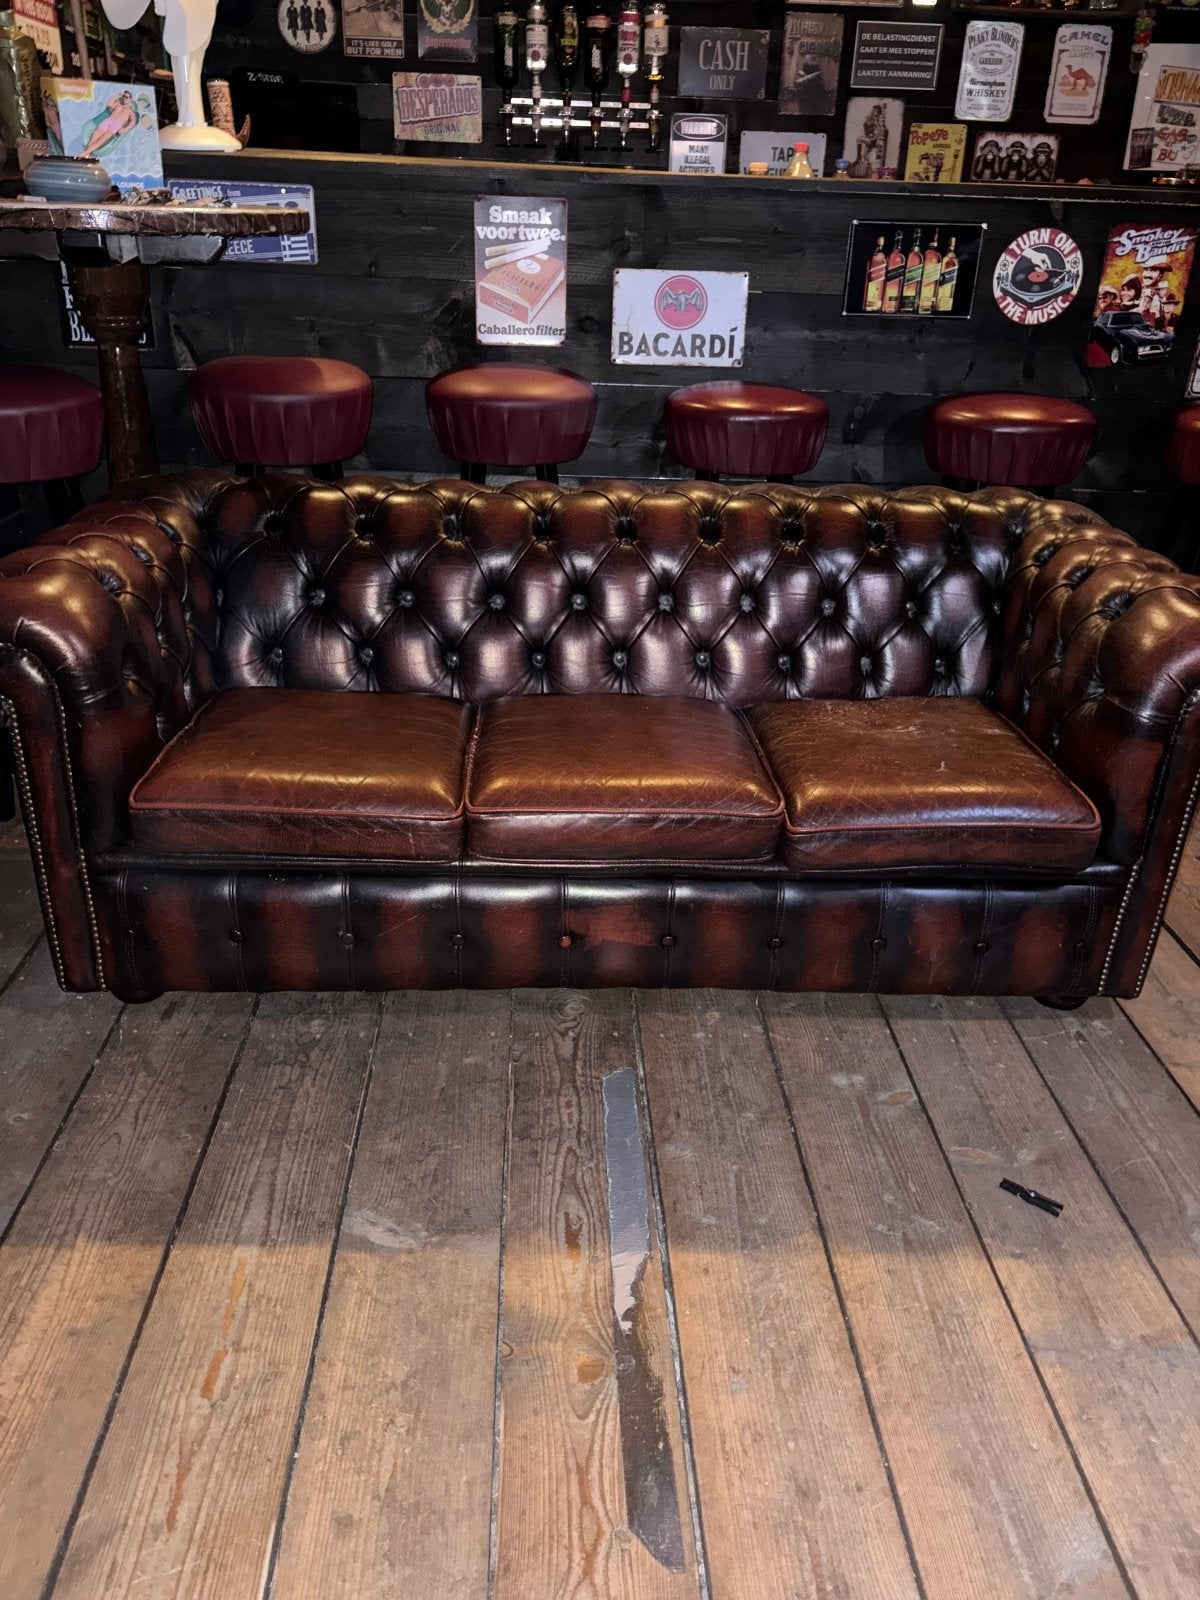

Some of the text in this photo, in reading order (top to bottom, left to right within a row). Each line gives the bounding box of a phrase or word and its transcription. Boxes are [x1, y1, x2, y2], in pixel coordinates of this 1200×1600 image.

[872, 33, 937, 42] BELASTINGDIENST
[968, 27, 1020, 51] PEAKY BLINDERS
[1058, 30, 1109, 46] CAMEL
[383, 48, 402, 56] MEN
[700, 39, 750, 71] CASH
[709, 75, 736, 91] ONLY
[966, 88, 1007, 98] WHISKEY
[399, 87, 479, 120] DESPERADOS
[424, 123, 460, 136] ORIGINAL
[680, 121, 718, 135] WARNING
[910, 129, 949, 146] Popeye
[688, 144, 709, 153] MANY
[684, 155, 711, 164] ILLEGAL
[117, 181, 145, 189] LOUNGE
[172, 185, 223, 202] GREETINGS
[489, 205, 552, 225] Smaak
[475, 224, 566, 241] voor twee.
[225, 239, 255, 255] EECE
[1008, 228, 1076, 255] TURN ON
[1113, 228, 1187, 256] Smokey
[1133, 241, 1188, 263] Bandit
[1000, 296, 1070, 325] THE MUSIC
[477, 324, 566, 337] Caballero filter.
[617, 327, 738, 359] BACARDÍ
